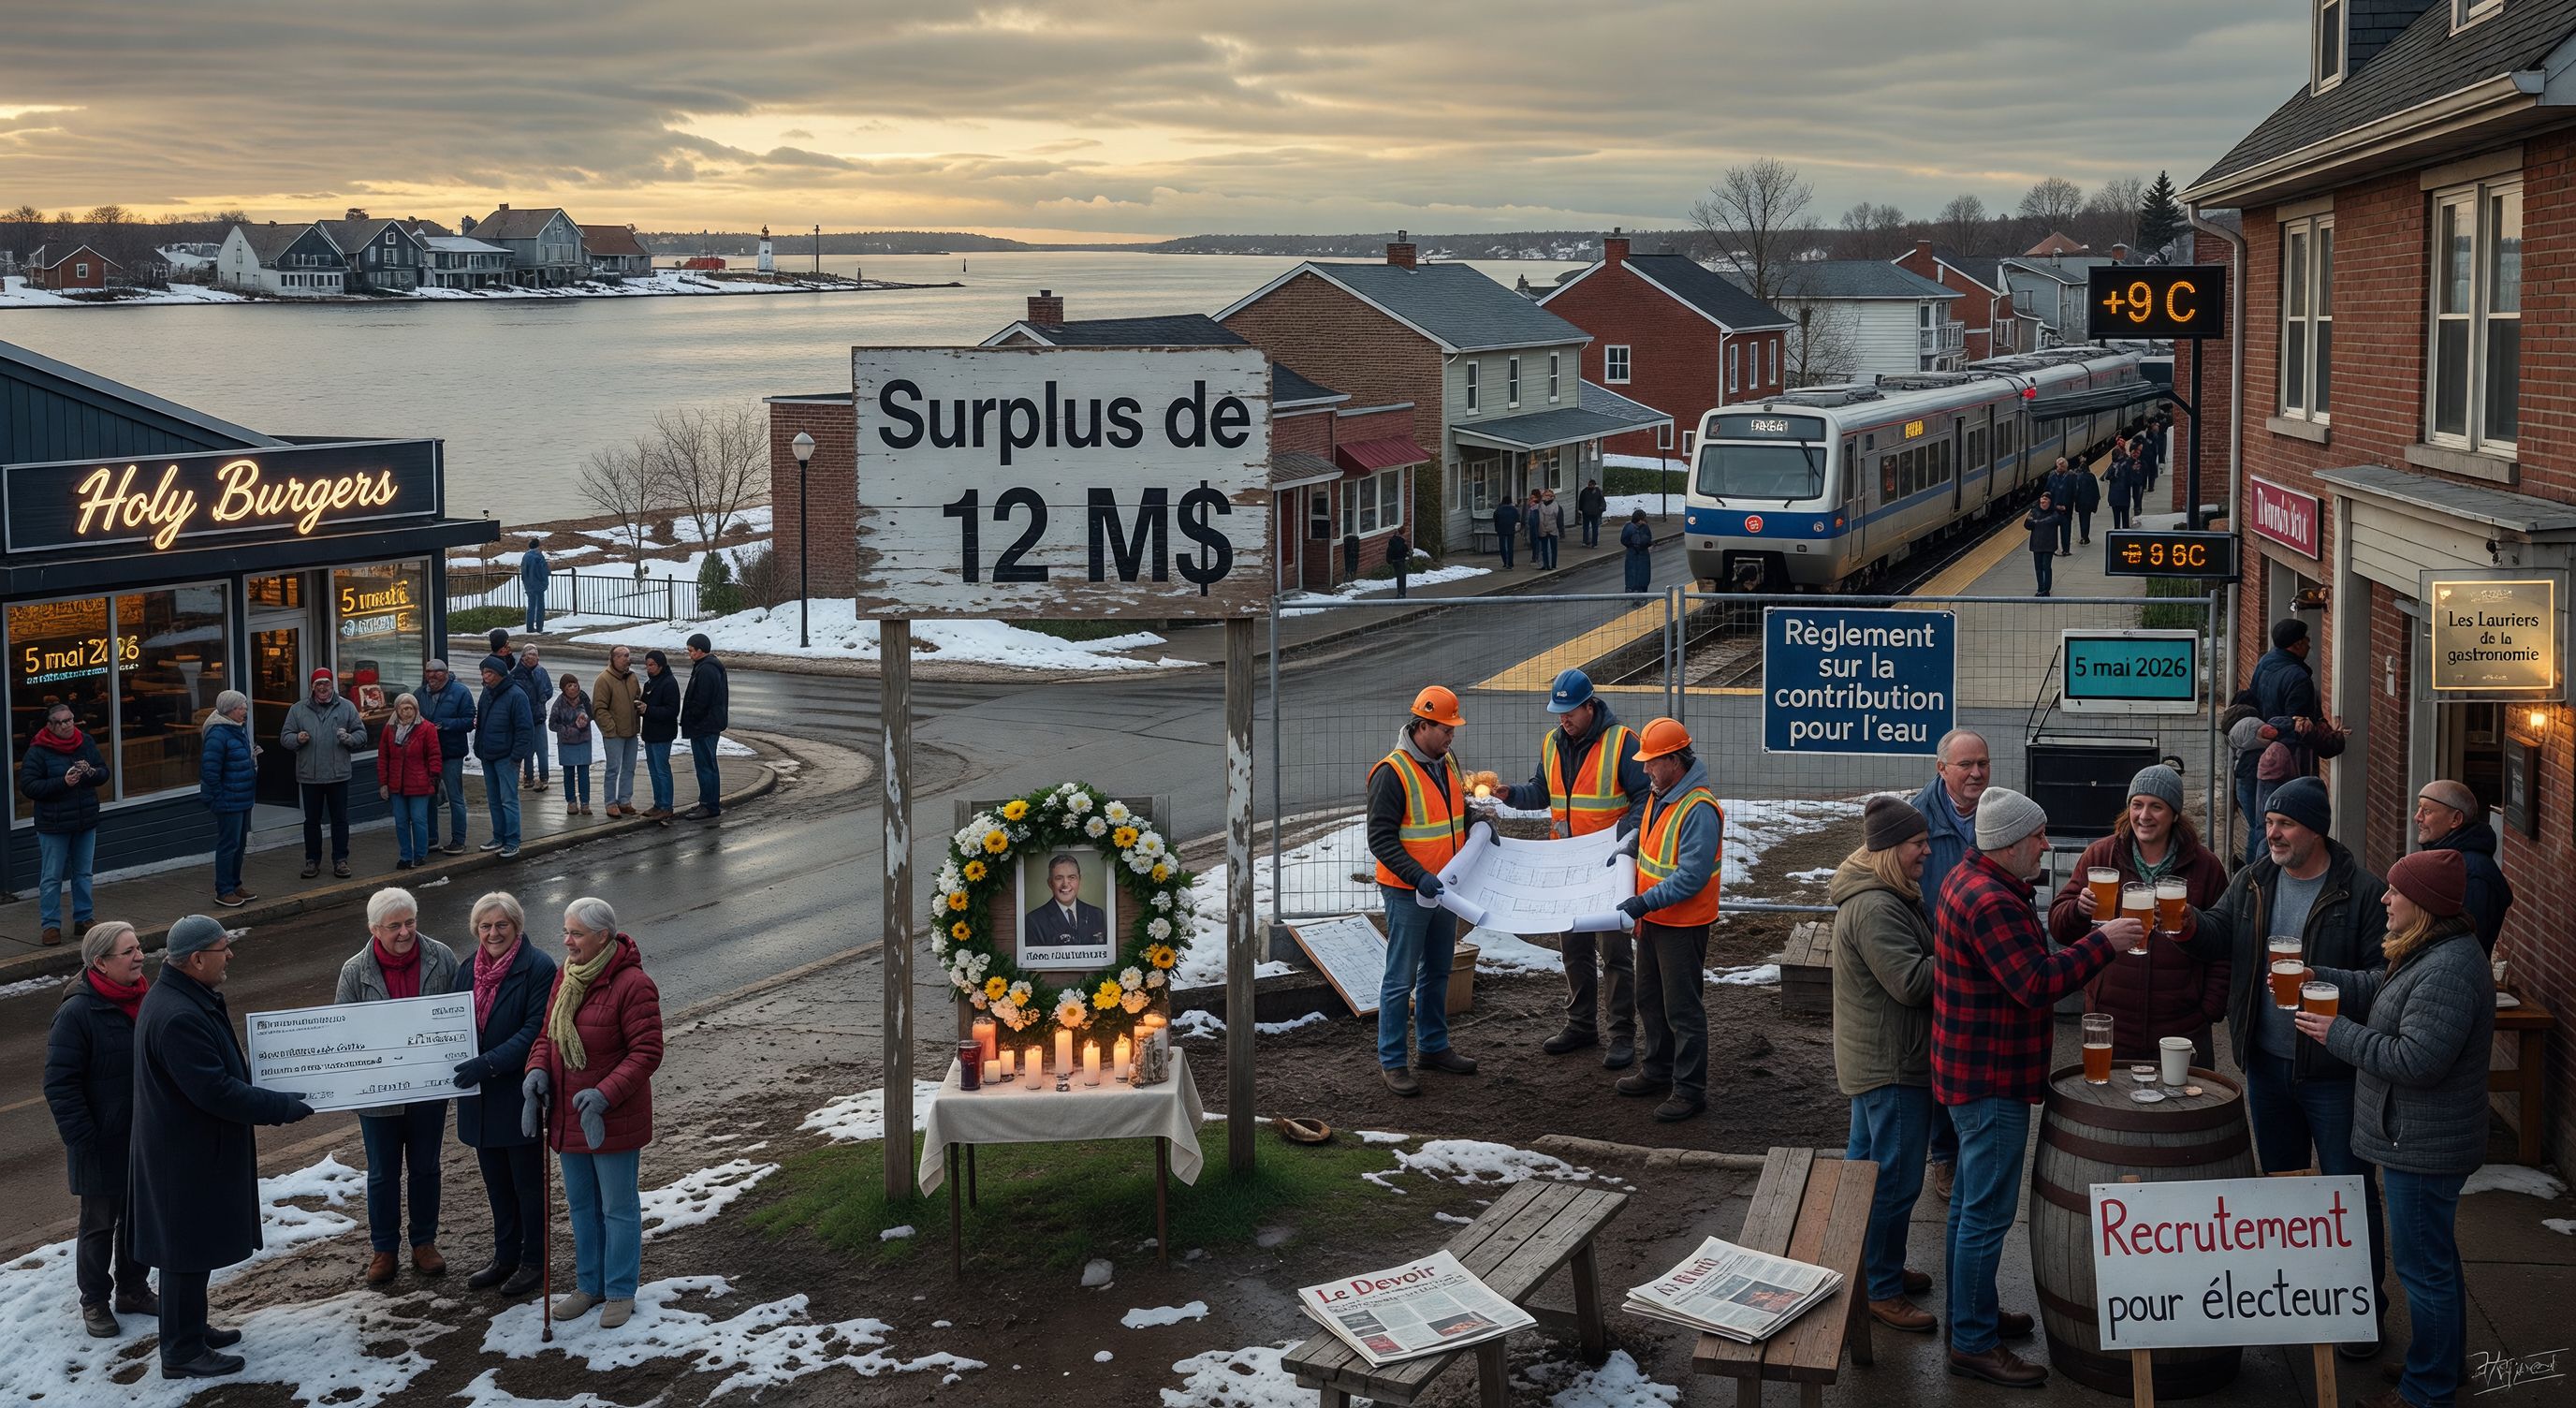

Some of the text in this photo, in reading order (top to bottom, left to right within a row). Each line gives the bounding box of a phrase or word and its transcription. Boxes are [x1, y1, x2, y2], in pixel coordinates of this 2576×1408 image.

[2102, 281, 2196, 322] +9 C
[878, 379, 1251, 465] Surplus de
[78, 460, 398, 550] Holy Burgers
[944, 480, 1233, 596] 12 M$
[1785, 619, 1935, 653] Règlement
[2449, 611, 2539, 627] Les Lauriers
[2480, 631, 2512, 645] de la
[25, 647, 40, 673] 5
[45, 640, 84, 669] mai
[1819, 652, 1895, 678] sur la
[2074, 657, 2188, 677] 5 mai 2026
[2448, 647, 2539, 666] gastronomie
[1775, 682, 1944, 711] contribution
[1790, 713, 1927, 747] pour l'eau
[2100, 1191, 2352, 1256] Recrutement
[1315, 1289, 1350, 1304] Le
[1350, 1266, 1435, 1296] Devoir
[2109, 1269, 2371, 1341] pour électeurs
